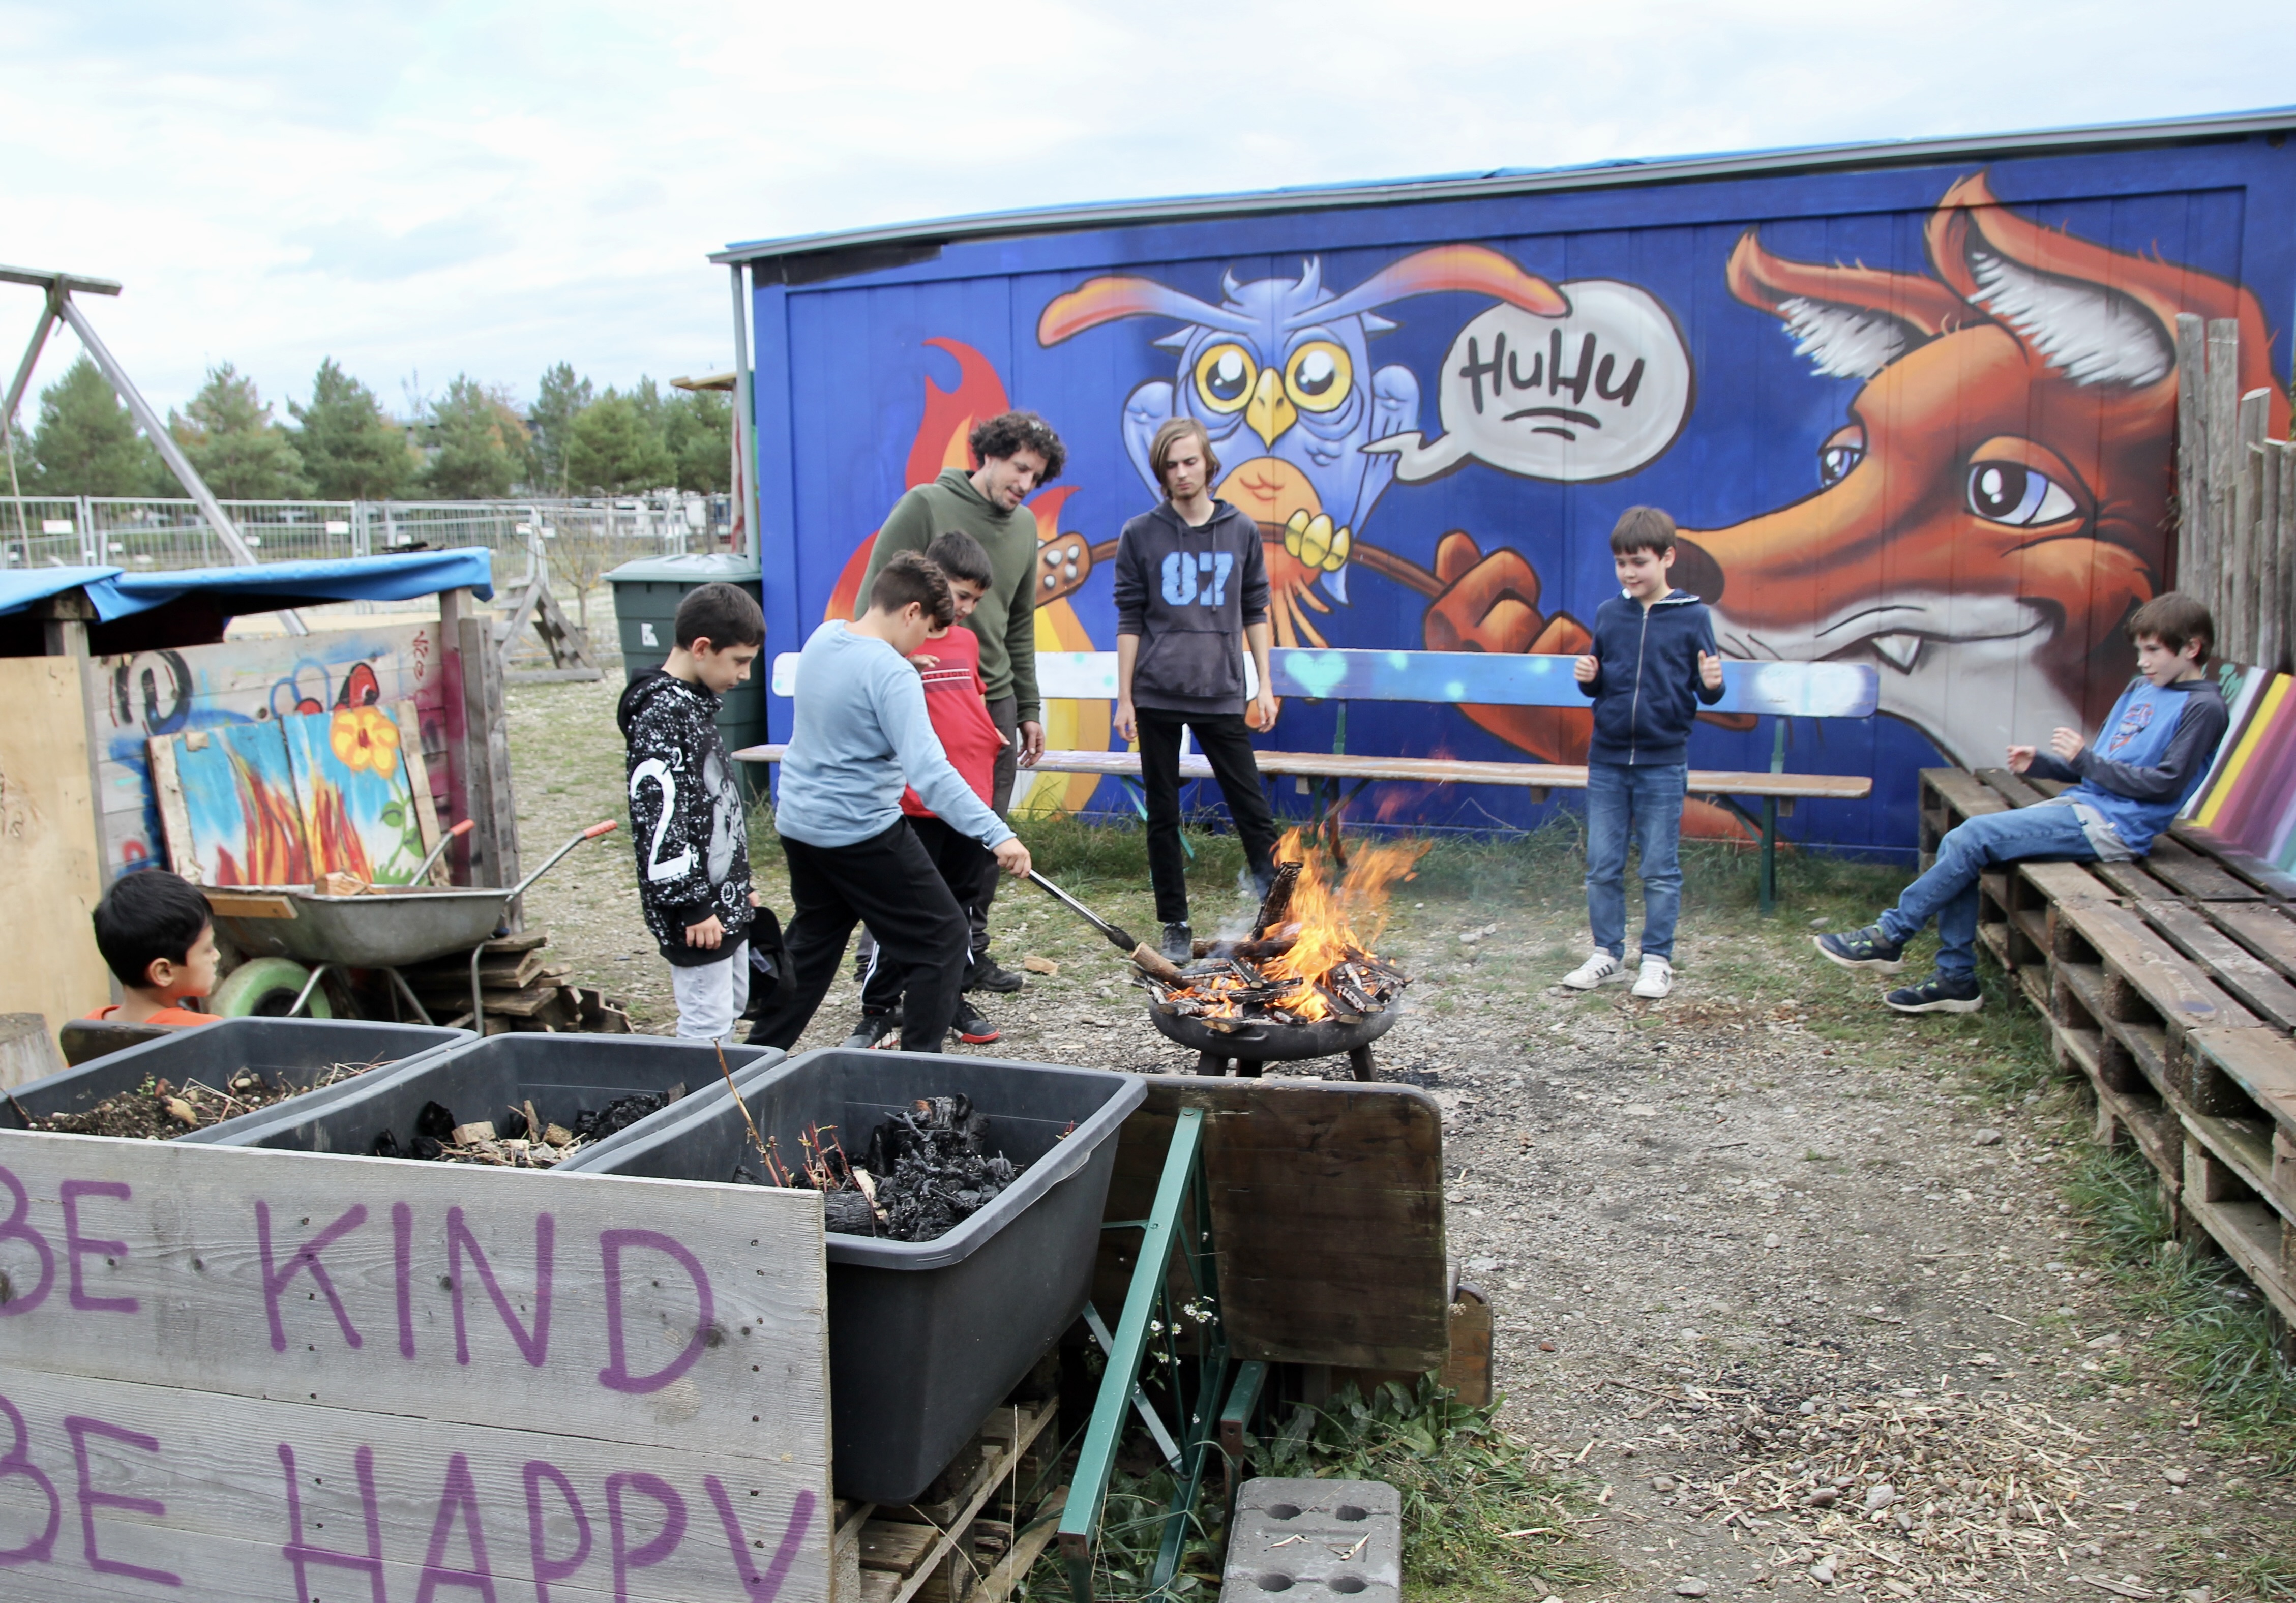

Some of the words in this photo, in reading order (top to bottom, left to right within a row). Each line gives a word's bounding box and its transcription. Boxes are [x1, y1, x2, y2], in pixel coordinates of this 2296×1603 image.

[1459, 329, 1646, 414] HuHu
[0, 1165, 140, 1316] BE
[255, 1200, 715, 1394] KIND
[0, 1394, 183, 1587] BE
